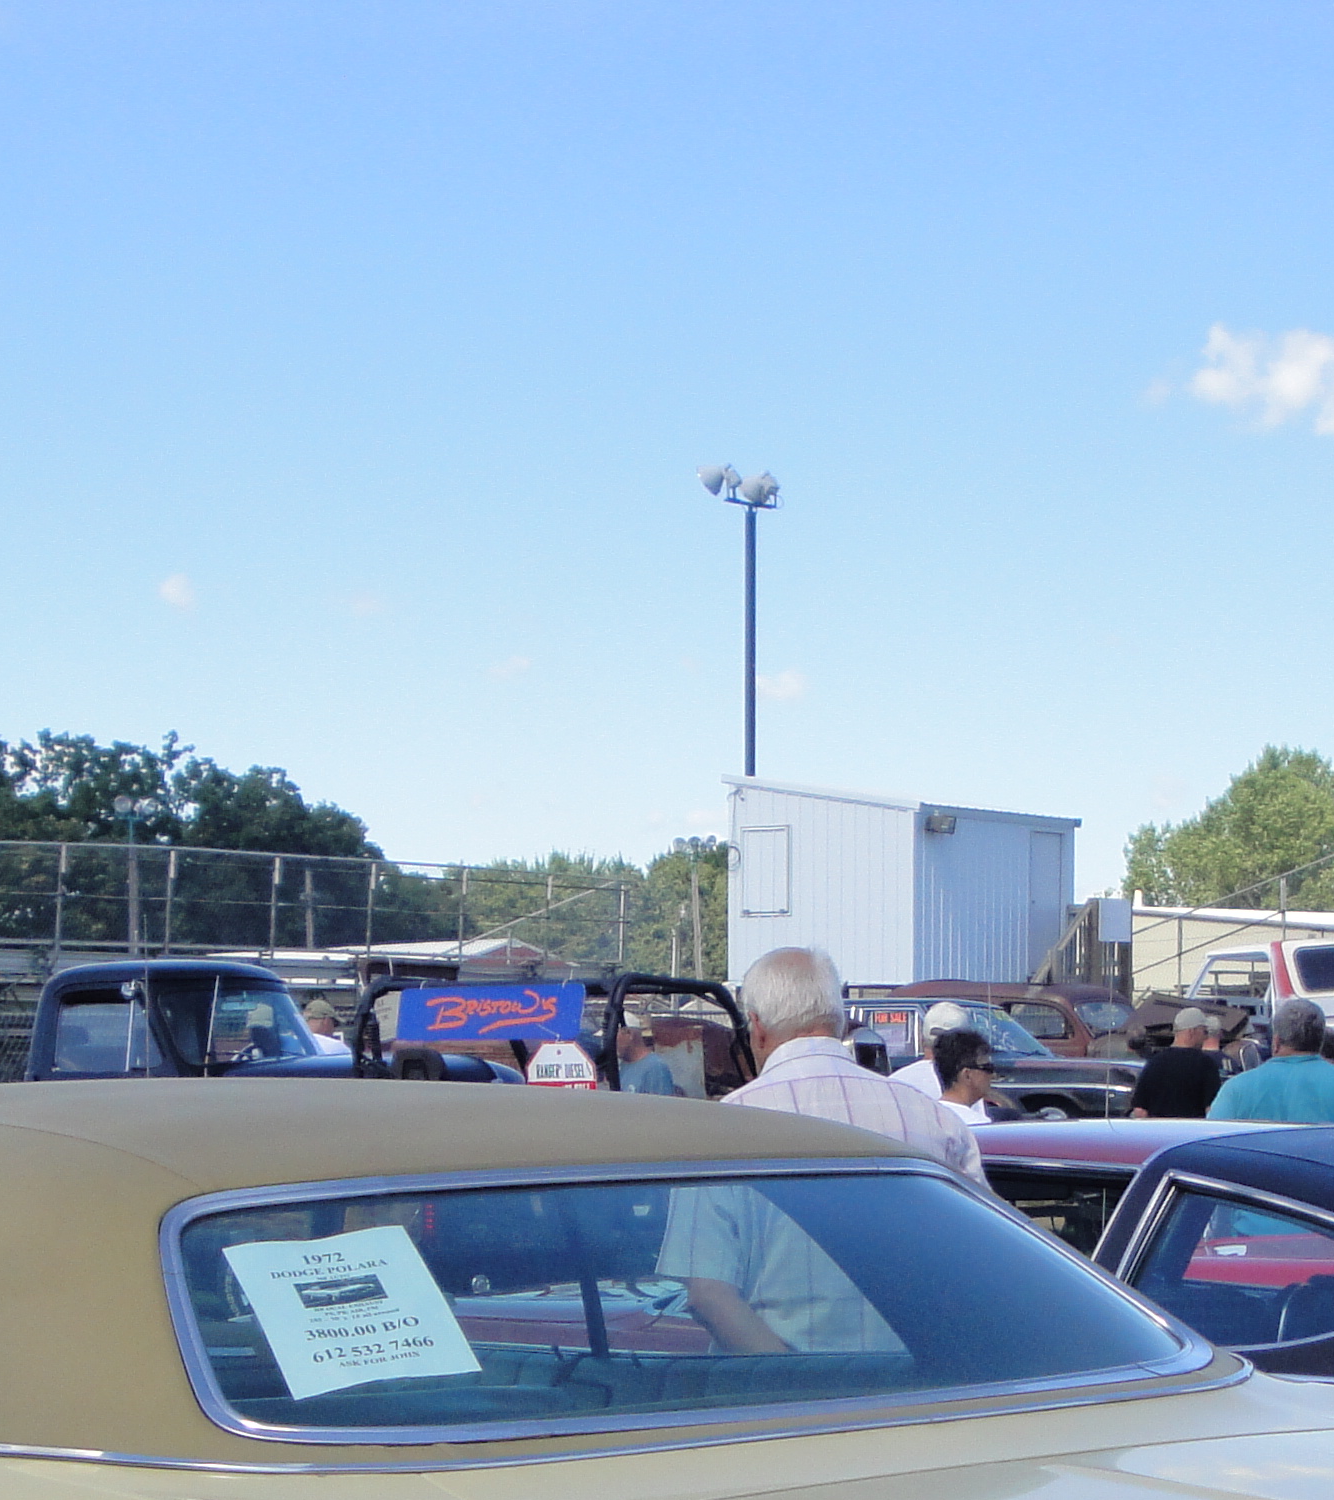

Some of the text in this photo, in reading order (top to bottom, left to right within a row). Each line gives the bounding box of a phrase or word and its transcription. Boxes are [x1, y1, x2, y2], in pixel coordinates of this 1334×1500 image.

[875, 1012, 907, 1023] FOR SALE
[302, 1252, 345, 1265] 1972
[270, 1258, 388, 1280] DODGE POLARA
[304, 1316, 420, 1341] 3800.00 B/O
[312, 1335, 435, 1363] 612 532 7466
[338, 1351, 421, 1368] ASK FOR JOHN
